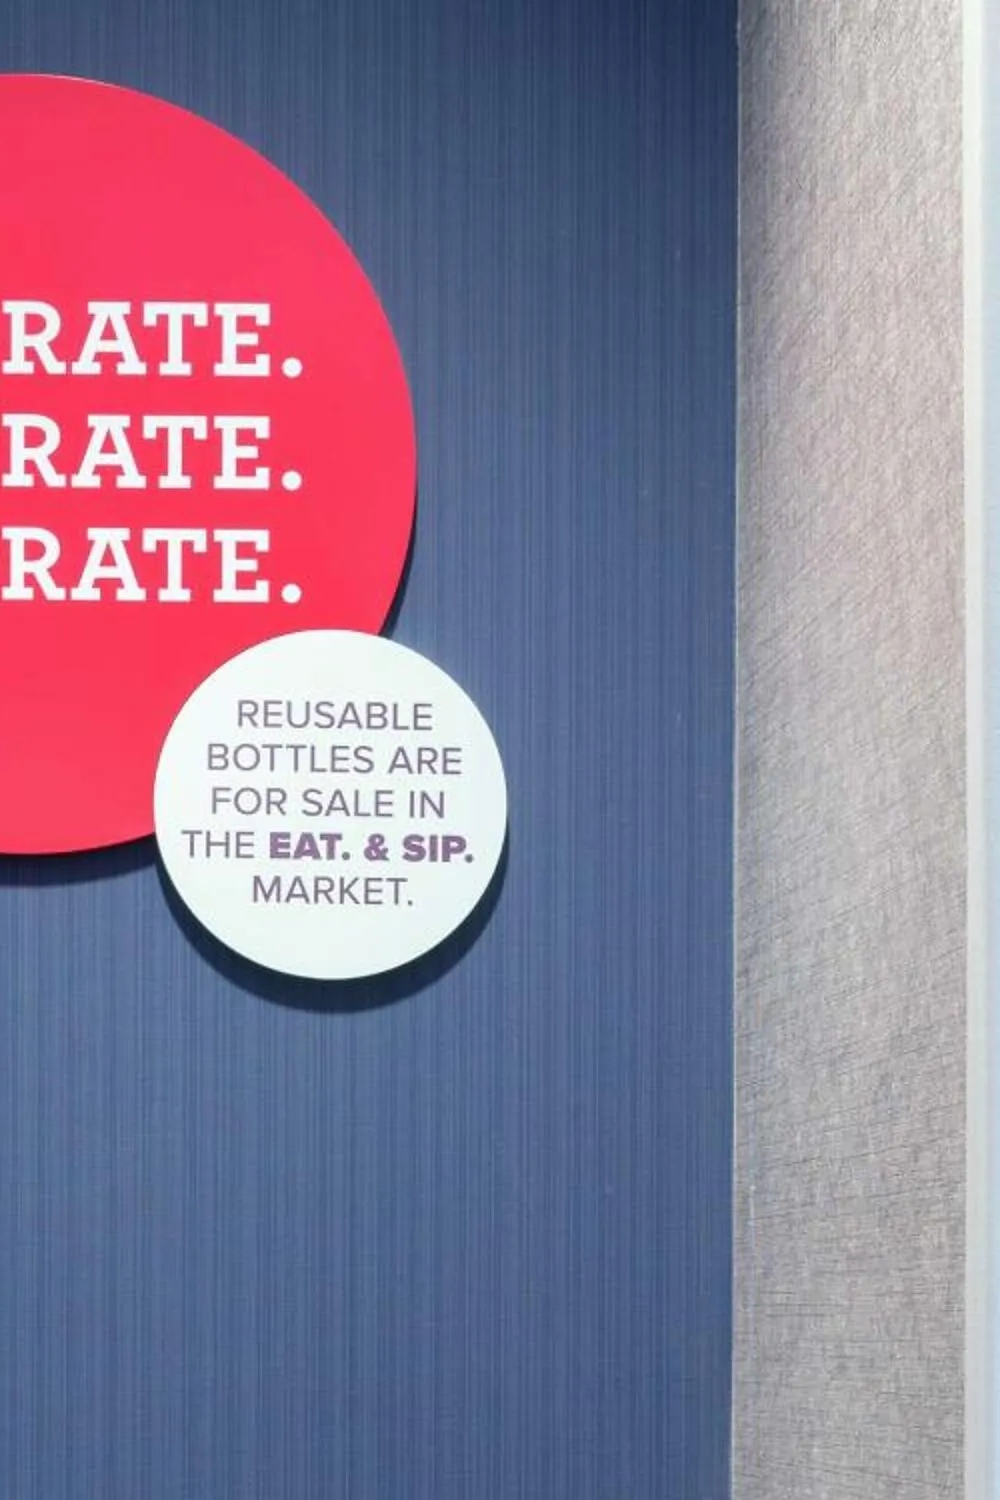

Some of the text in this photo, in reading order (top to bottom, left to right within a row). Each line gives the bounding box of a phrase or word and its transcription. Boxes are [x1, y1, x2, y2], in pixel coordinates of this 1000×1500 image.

[237, 699, 433, 731] REUSABLE
[207, 743, 462, 775] BOTTLES ARE
[211, 787, 445, 819] FOR SALE IN
[181, 829, 474, 864] THE EAT. & SIP.
[253, 875, 413, 906] MARKET.
